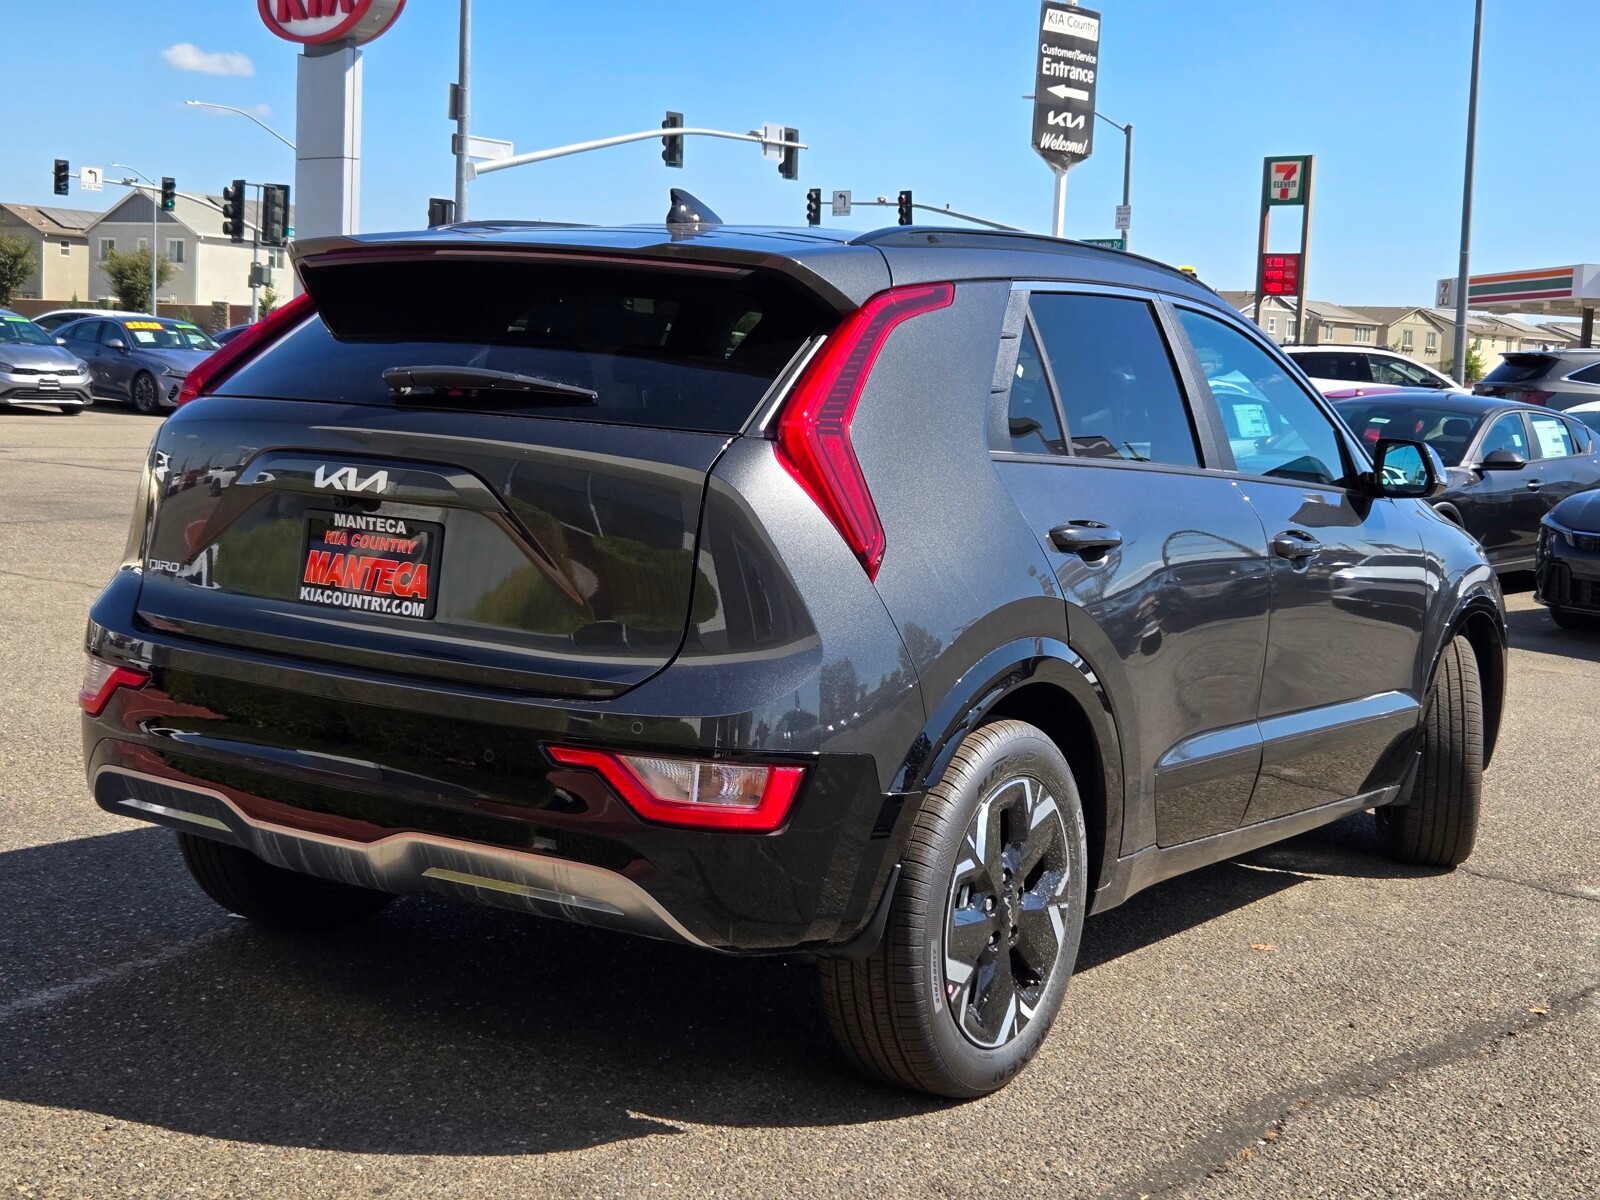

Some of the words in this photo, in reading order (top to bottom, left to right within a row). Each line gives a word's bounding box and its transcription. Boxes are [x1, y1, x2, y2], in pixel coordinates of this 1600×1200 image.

[1048, 12, 1064, 25] KIA
[1067, 16, 1097, 37] Country
[1041, 43, 1097, 64] Customer/Service
[1042, 57, 1095, 83] Entrance
[1040, 132, 1089, 155] Welcome!
[1275, 163, 1298, 199] 7
[314, 464, 389, 494] KIA
[334, 513, 407, 535] MANTECA
[324, 530, 348, 546] KIA
[350, 534, 418, 555] COUNTRY
[303, 549, 428, 600] MANTECA
[300, 586, 425, 617] KIACOUNTRY.COM
